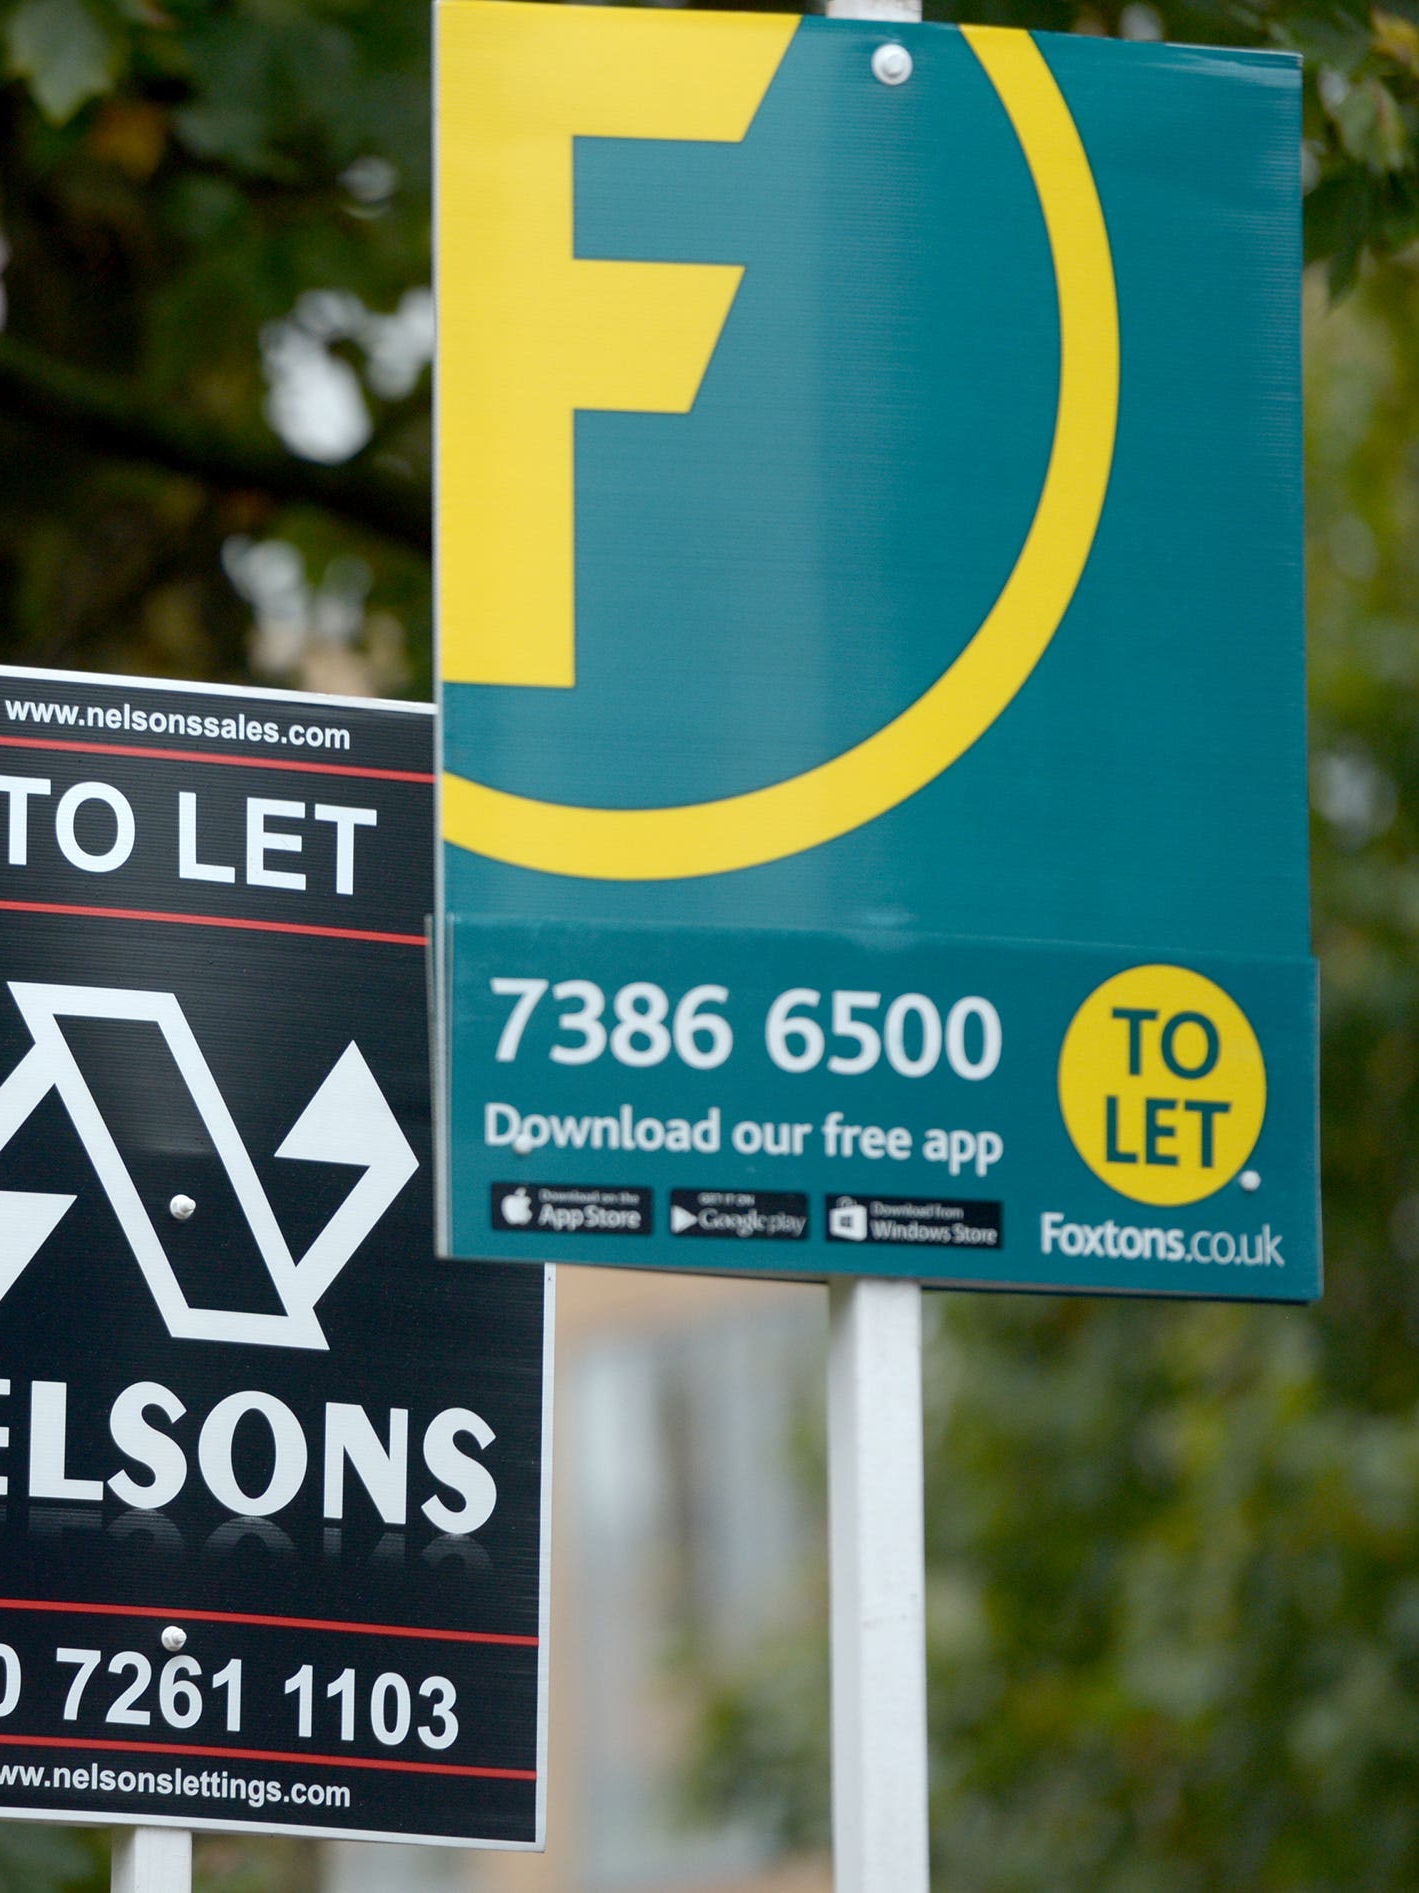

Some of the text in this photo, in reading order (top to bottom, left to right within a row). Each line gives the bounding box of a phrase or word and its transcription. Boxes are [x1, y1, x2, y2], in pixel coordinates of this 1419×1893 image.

[438, 0, 802, 688] F
[5, 699, 350, 750] www.nelsonssales.com
[179, 791, 377, 895] LET
[490, 977, 1002, 1080] 7386 6500
[1112, 1007, 1220, 1080] TO
[485, 1102, 1003, 1177] Download our free app
[1106, 1095, 1231, 1168] LET
[538, 1203, 641, 1230] App Store
[539, 1188, 600, 1204] Download
[697, 1208, 807, 1237] Google play
[870, 1202, 964, 1220] Download from
[870, 1219, 998, 1245] Windows Store
[1041, 1212, 1284, 1266] Foxtons.co.uk
[56, 1647, 242, 1732] 7261
[285, 1664, 458, 1749] 1103
